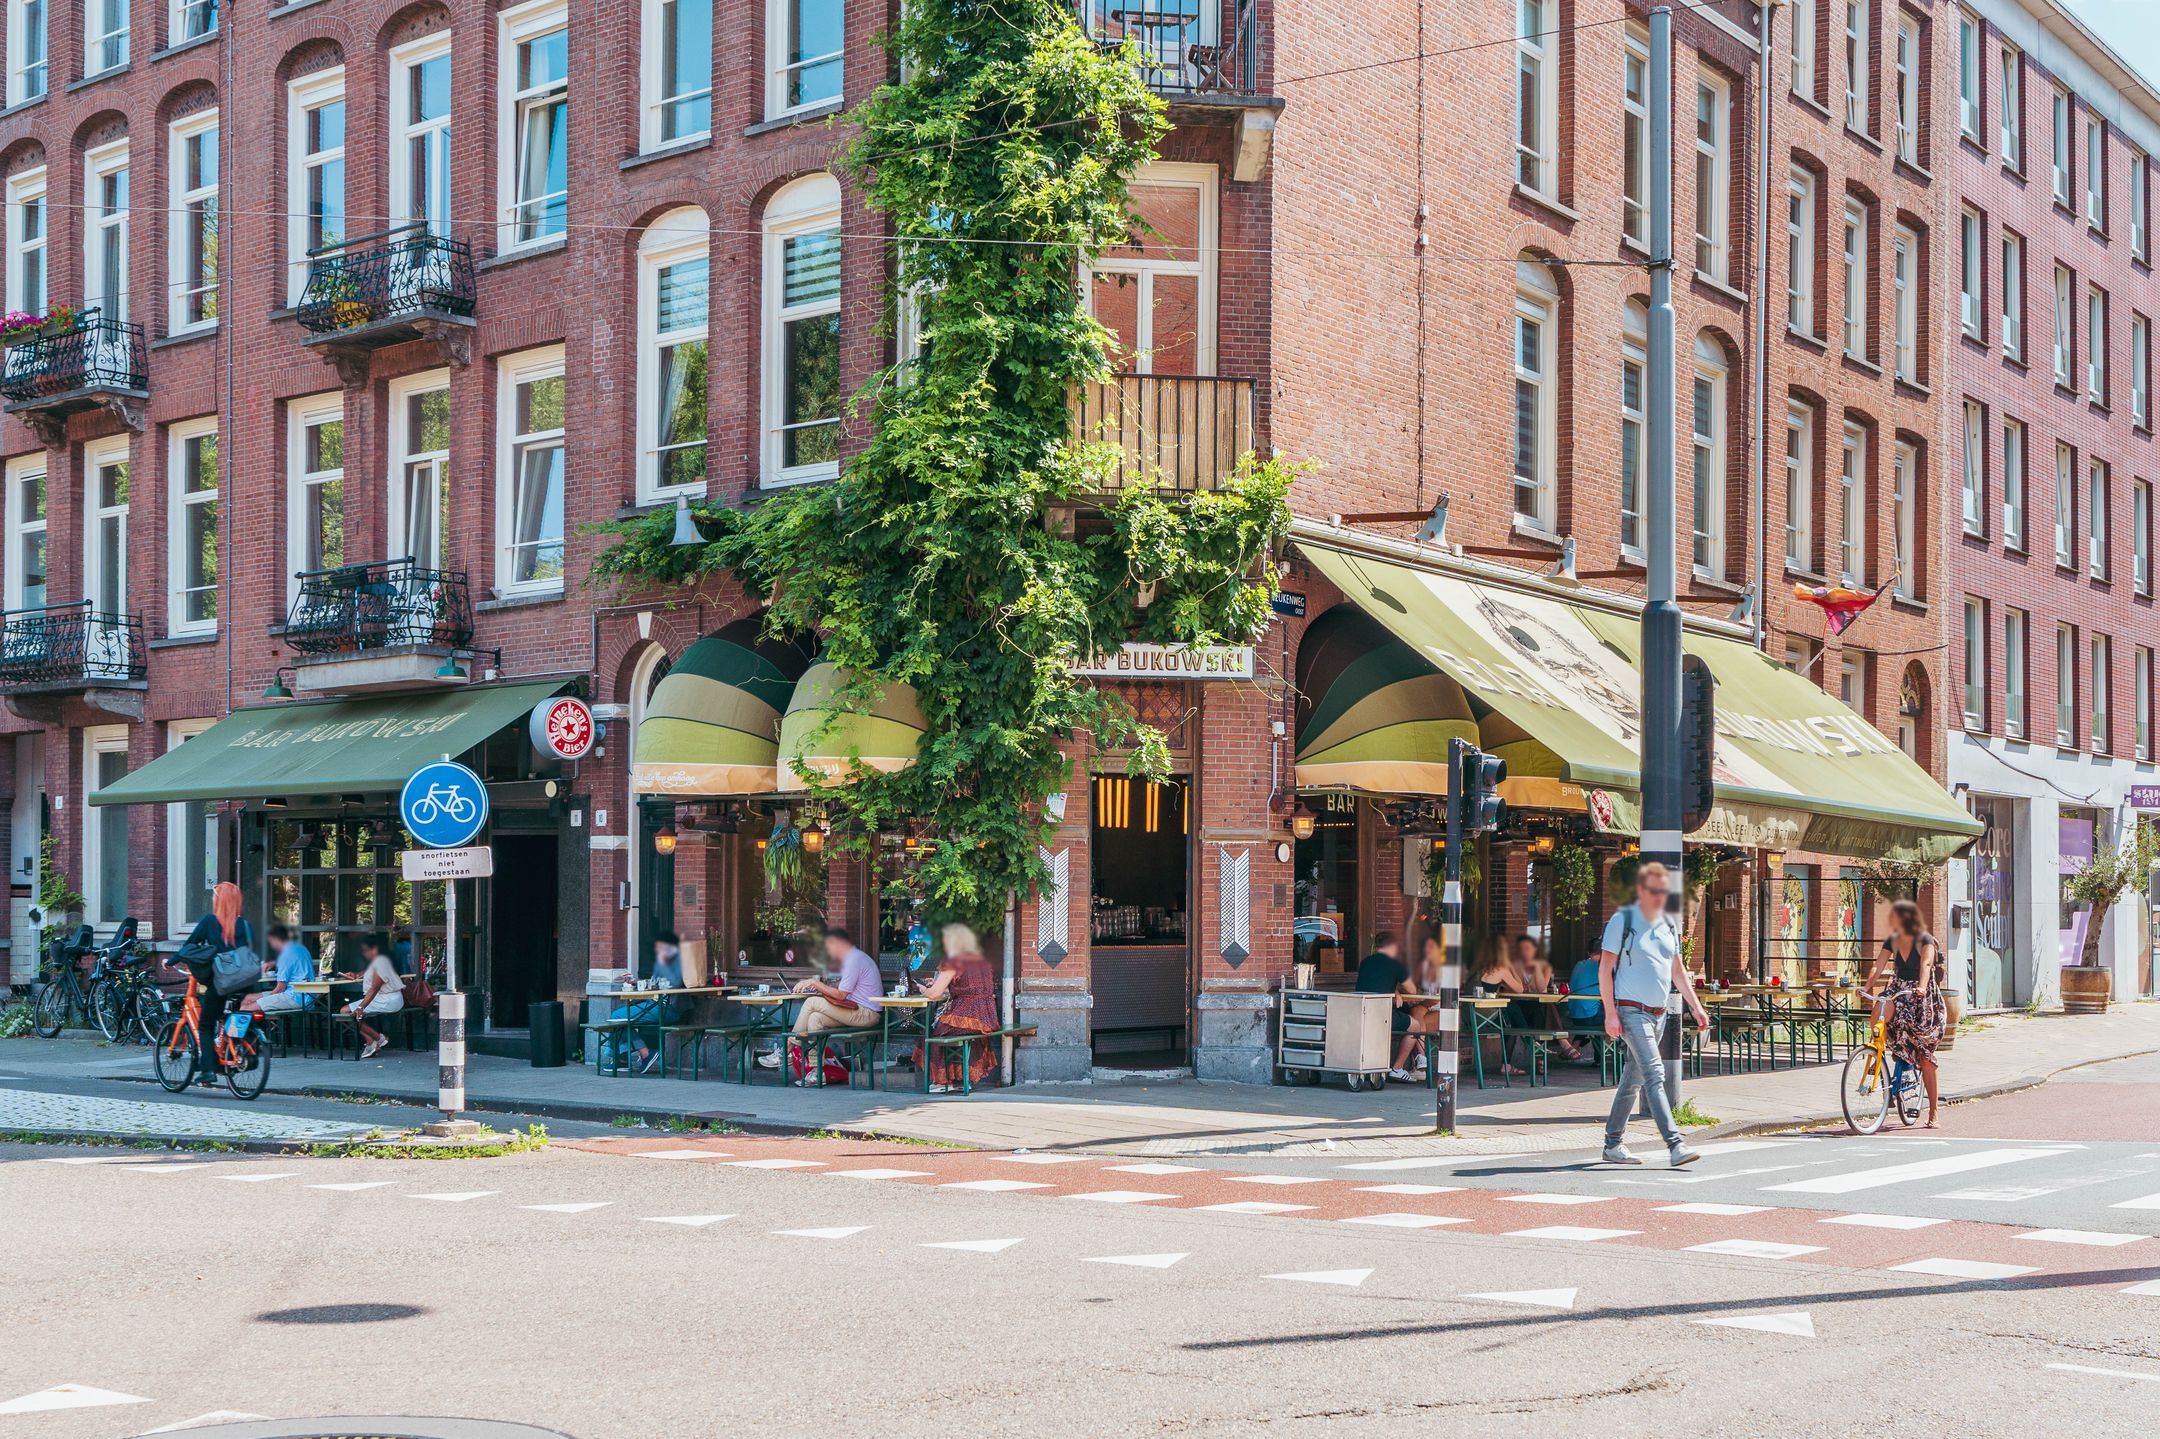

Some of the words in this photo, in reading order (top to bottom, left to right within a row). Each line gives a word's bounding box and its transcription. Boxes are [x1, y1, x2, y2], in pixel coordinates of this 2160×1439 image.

[1117, 650, 1244, 674] BUKOWSKI
[229, 728, 297, 748] BAR
[292, 712, 468, 744] BUKOWSKI
[549, 702, 588, 747] Heineken's
[563, 740, 585, 753] Bier
[1327, 794, 1355, 814] BAR
[1976, 814, 2011, 857] Core
[421, 851, 469, 859] snorfietsen
[424, 869, 470, 877] toegestaan
